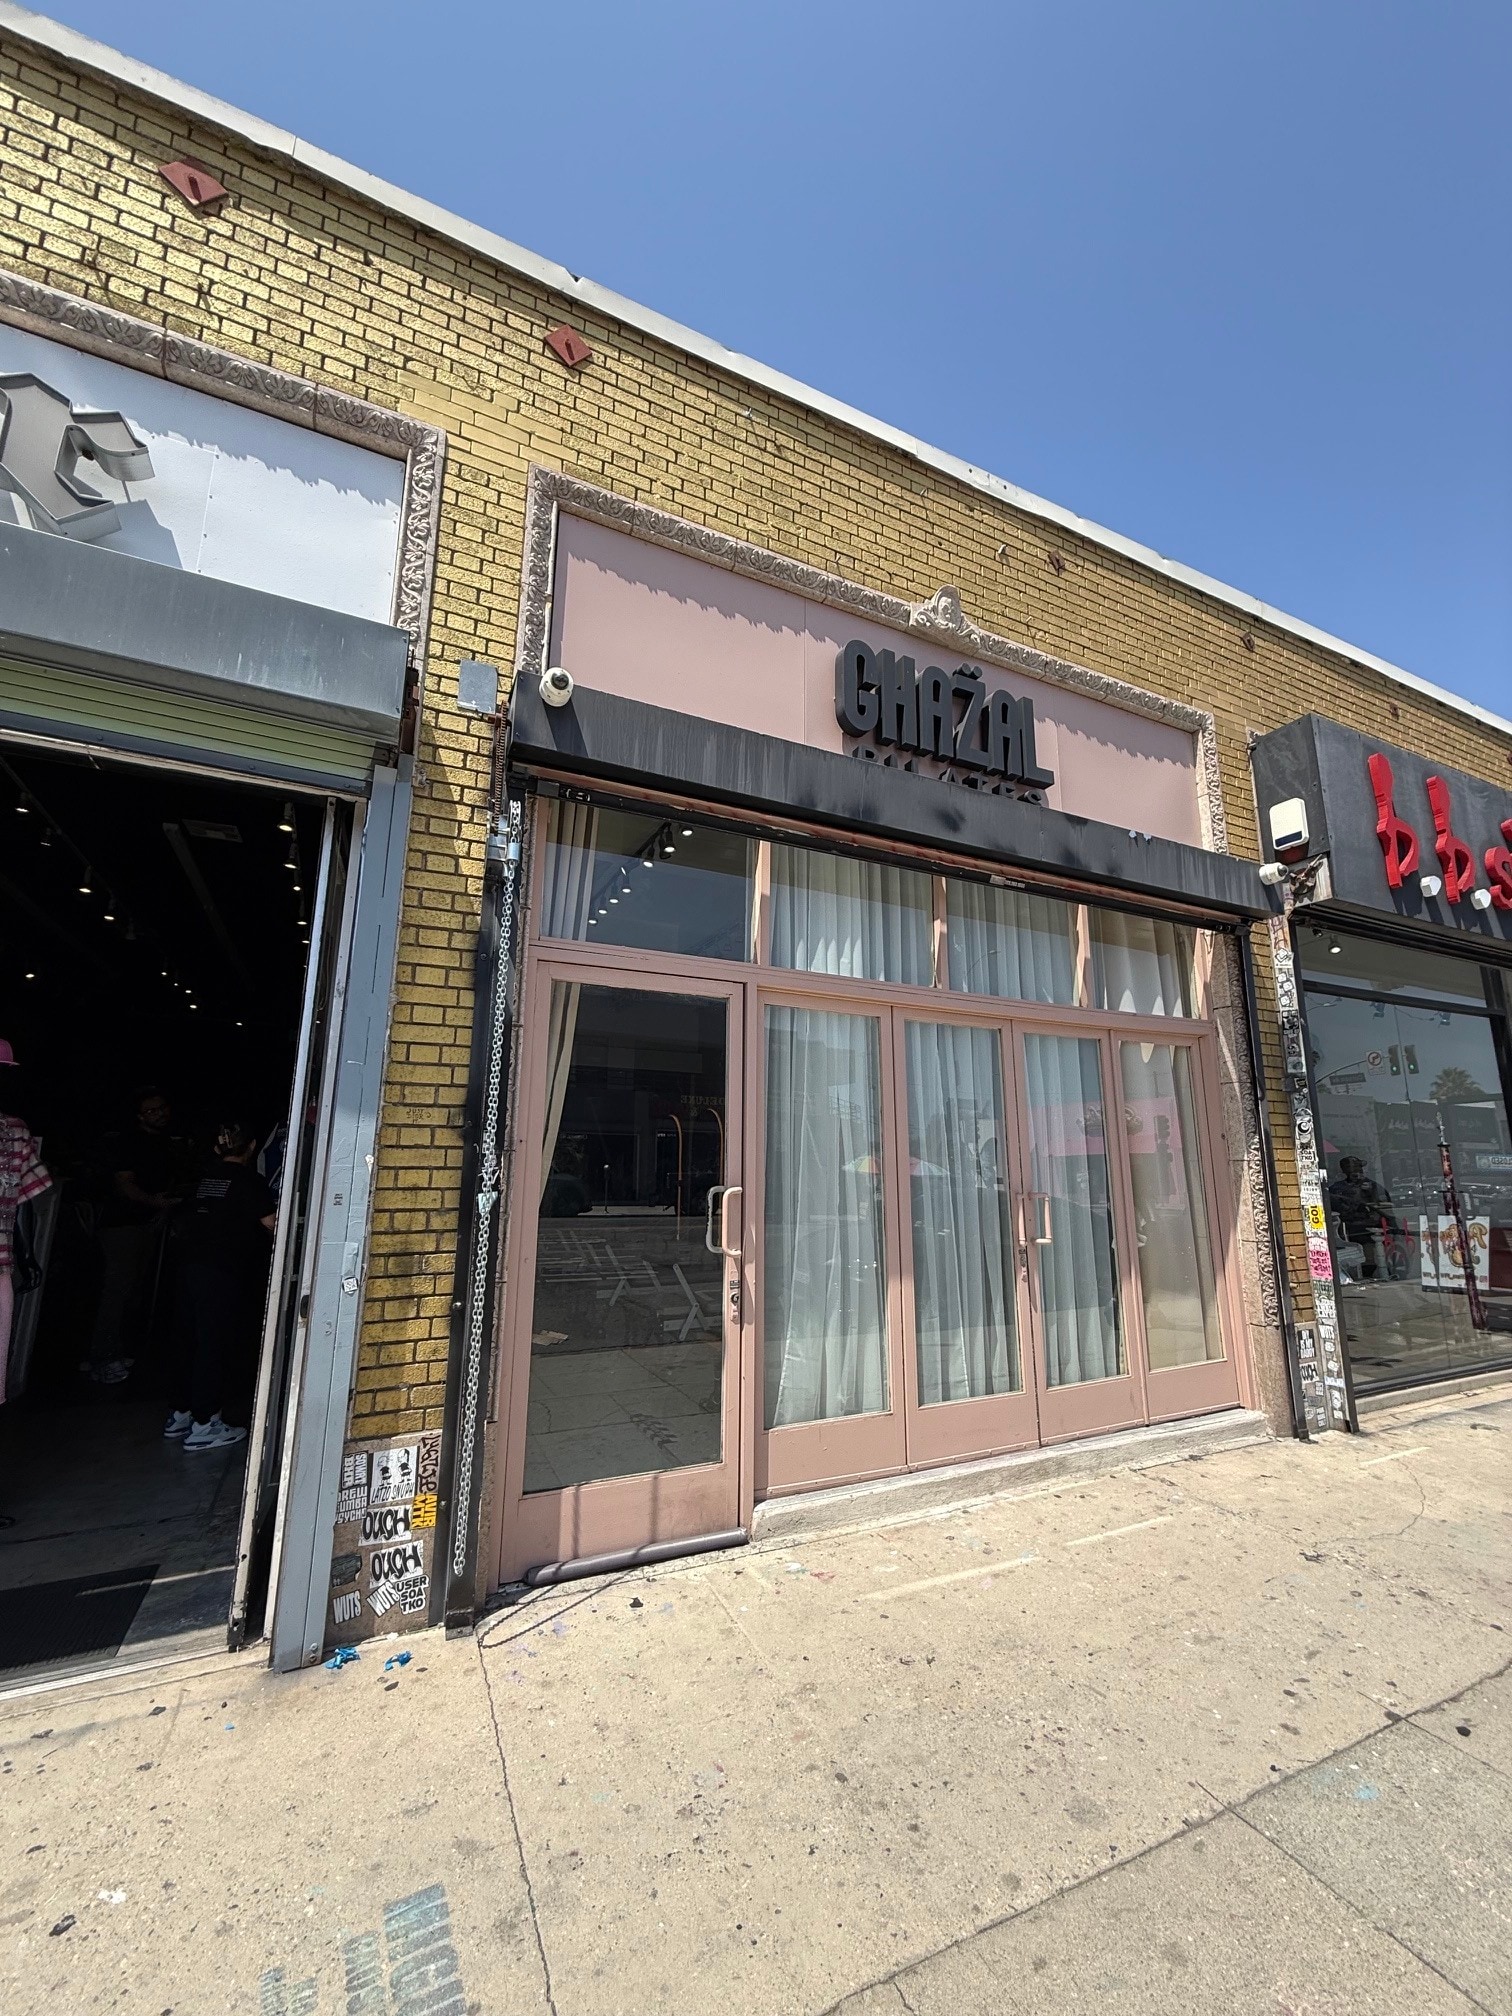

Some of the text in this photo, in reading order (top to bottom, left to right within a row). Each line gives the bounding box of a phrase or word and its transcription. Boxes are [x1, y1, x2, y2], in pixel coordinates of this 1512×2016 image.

[335, 1508, 366, 1524] SYCHO
[396, 1576, 427, 1592] USER
[367, 1580, 399, 1617] WUTS
[401, 1589, 424, 1602] SOA
[333, 1590, 362, 1624] WUTS
[402, 1598, 424, 1613] TKO
